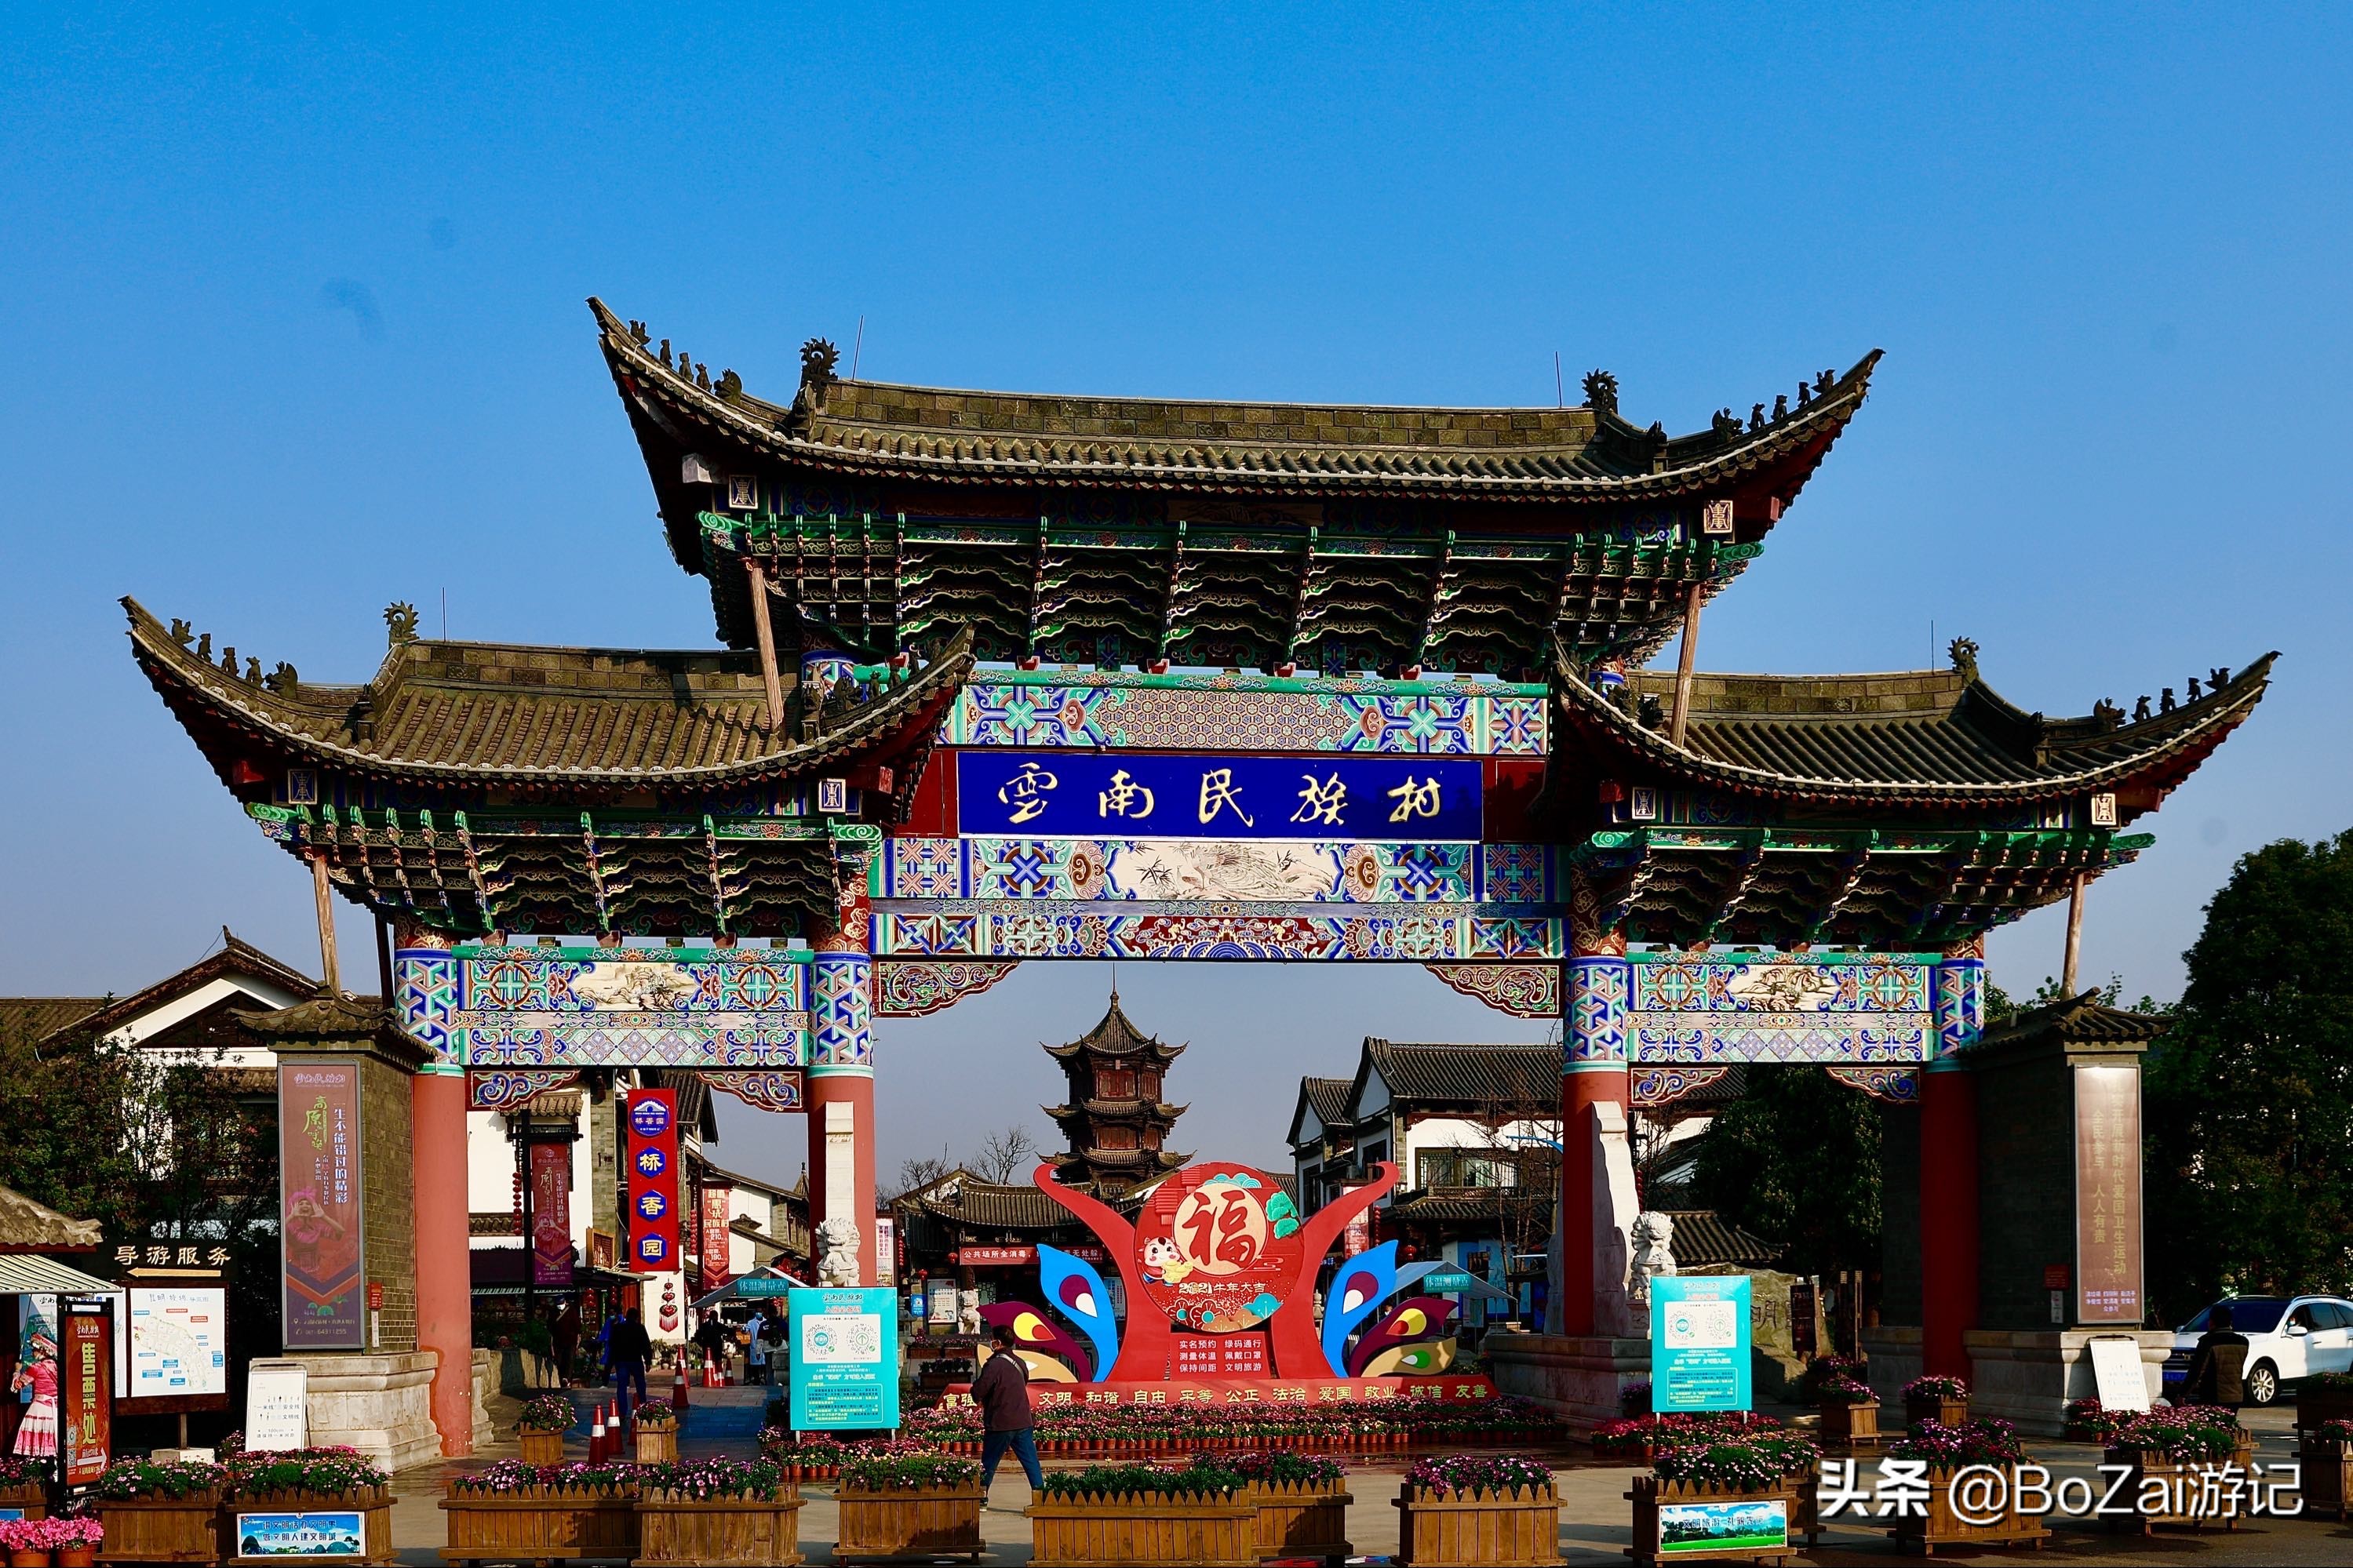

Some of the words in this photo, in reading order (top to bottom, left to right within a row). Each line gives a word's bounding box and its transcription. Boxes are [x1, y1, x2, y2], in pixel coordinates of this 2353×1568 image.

[333, 1102, 348, 1204] 一生不能错过的精彩
[2092, 1110, 2104, 1169] 全民参与
[639, 1153, 665, 1257] 桥香园
[1182, 1190, 1256, 1269] 福
[2093, 1184, 2106, 1242] 人人有责
[114, 1246, 231, 1266] 导游服务
[1179, 1340, 1217, 1349] 实名预约
[1224, 1339, 1262, 1348] 绿码通行
[1179, 1352, 1217, 1361] 测量体温
[1225, 1351, 1262, 1360] 佩戴口罩
[1179, 1363, 1217, 1373] 保持间距
[1225, 1362, 1262, 1372] 文明旅游
[82, 1342, 96, 1444] 售票处
[943, 1392, 977, 1409] 富强
[1039, 1392, 1072, 1405] 文明
[1086, 1391, 1120, 1404] 和谐
[1134, 1389, 1167, 1404] 自由
[1179, 1389, 1213, 1404] 平等
[1226, 1388, 1259, 1402] 公正
[1273, 1388, 1306, 1401] 法治
[1319, 1386, 1352, 1401] 爱国
[1364, 1385, 1397, 1399] 敬业
[1411, 1385, 1443, 1399] 诚信
[1456, 1384, 1488, 1399] 友善
